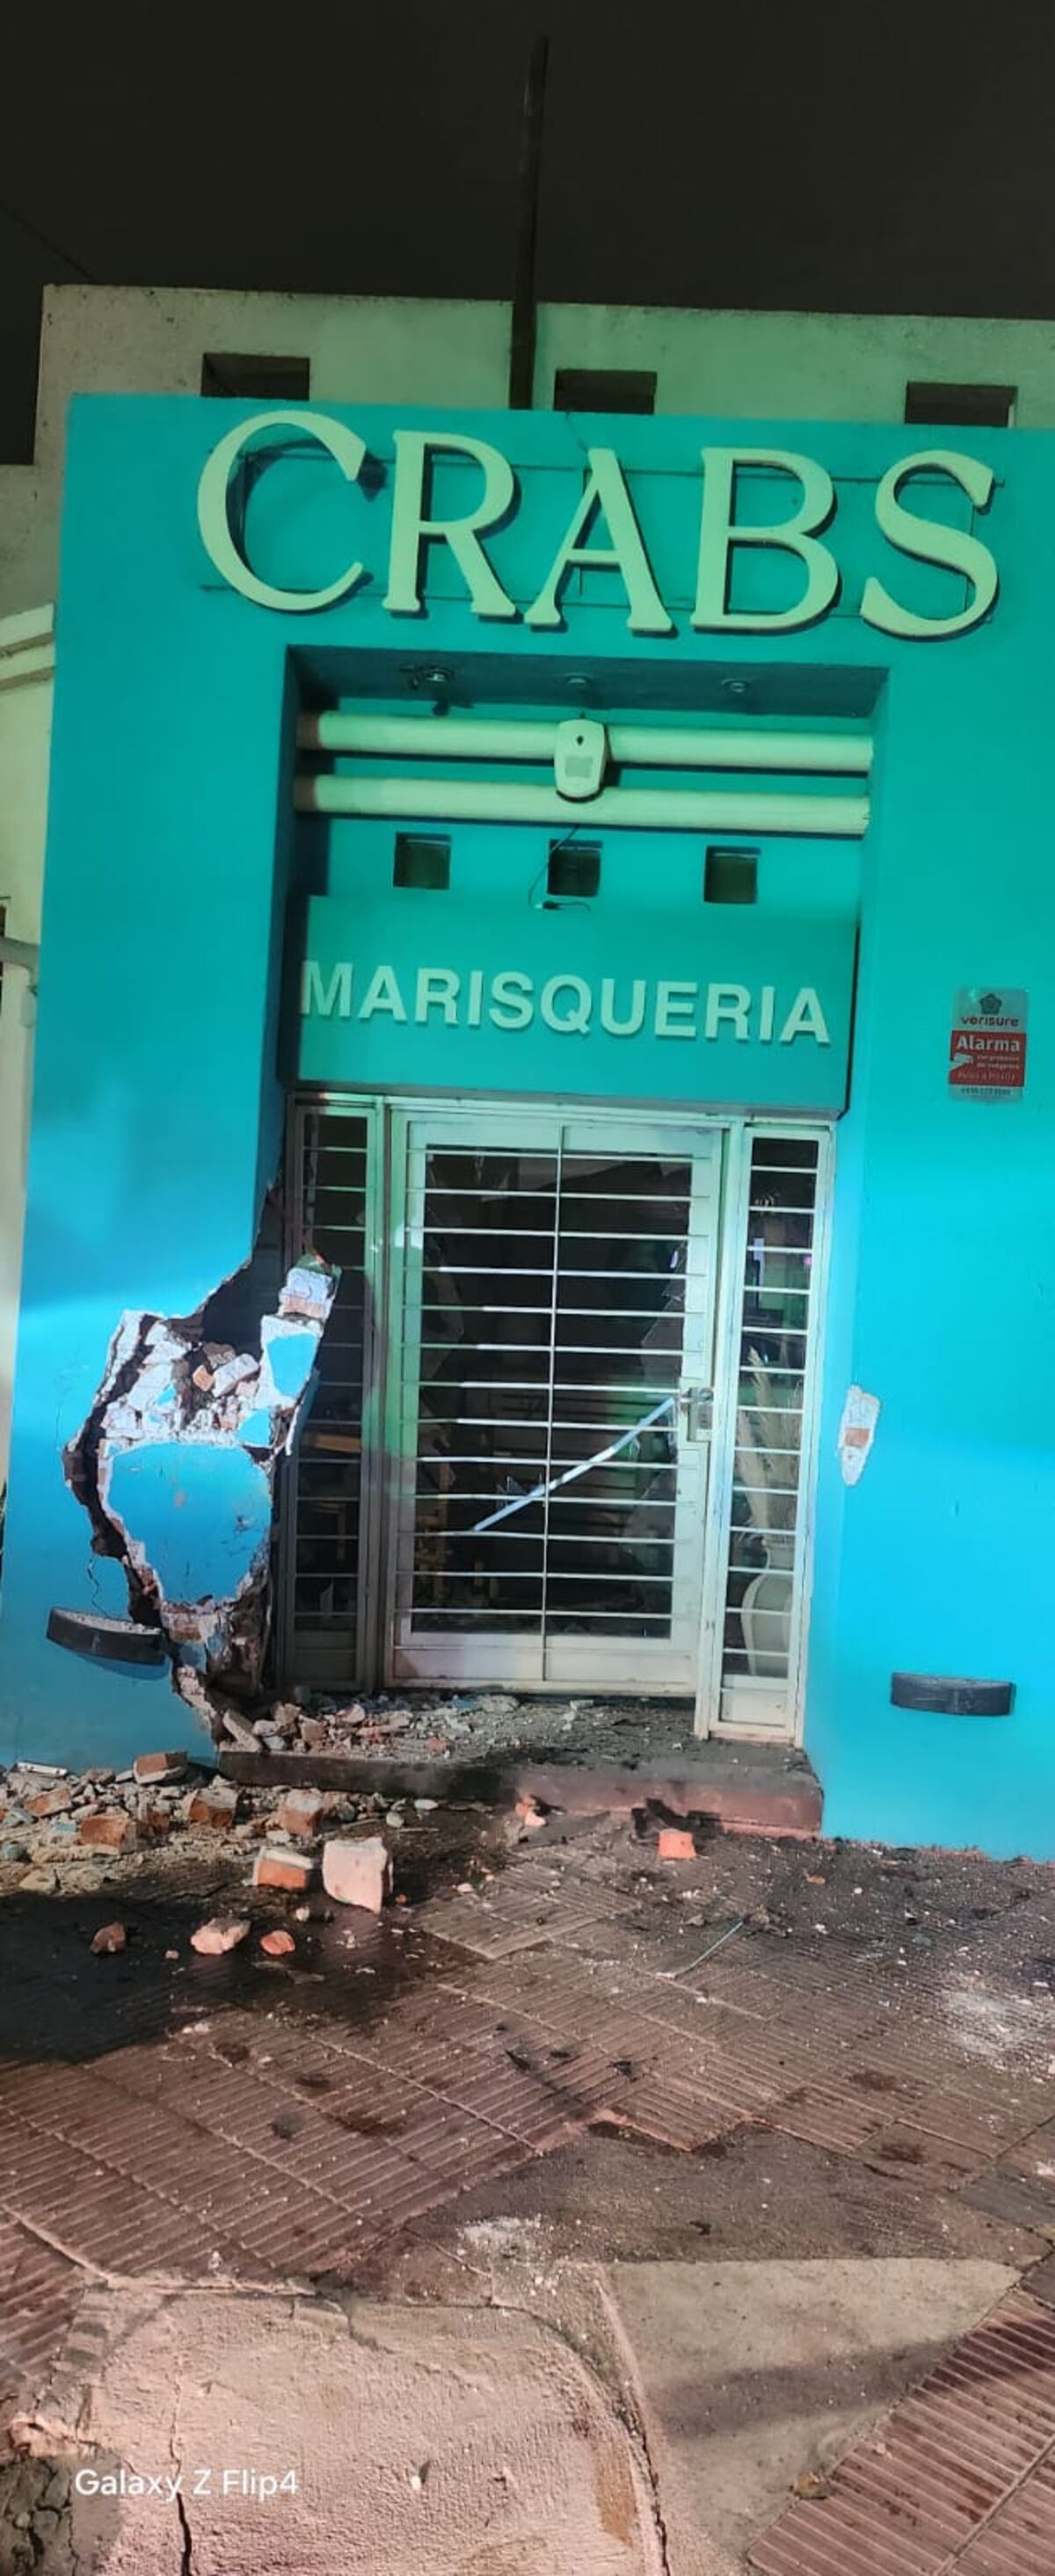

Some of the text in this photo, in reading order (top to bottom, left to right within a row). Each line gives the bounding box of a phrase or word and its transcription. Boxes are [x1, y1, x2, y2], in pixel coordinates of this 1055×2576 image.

[196, 410, 1000, 639] CRABS
[300, 960, 831, 1044] MARISQUERIA
[957, 1034, 1020, 1053] Alarma
